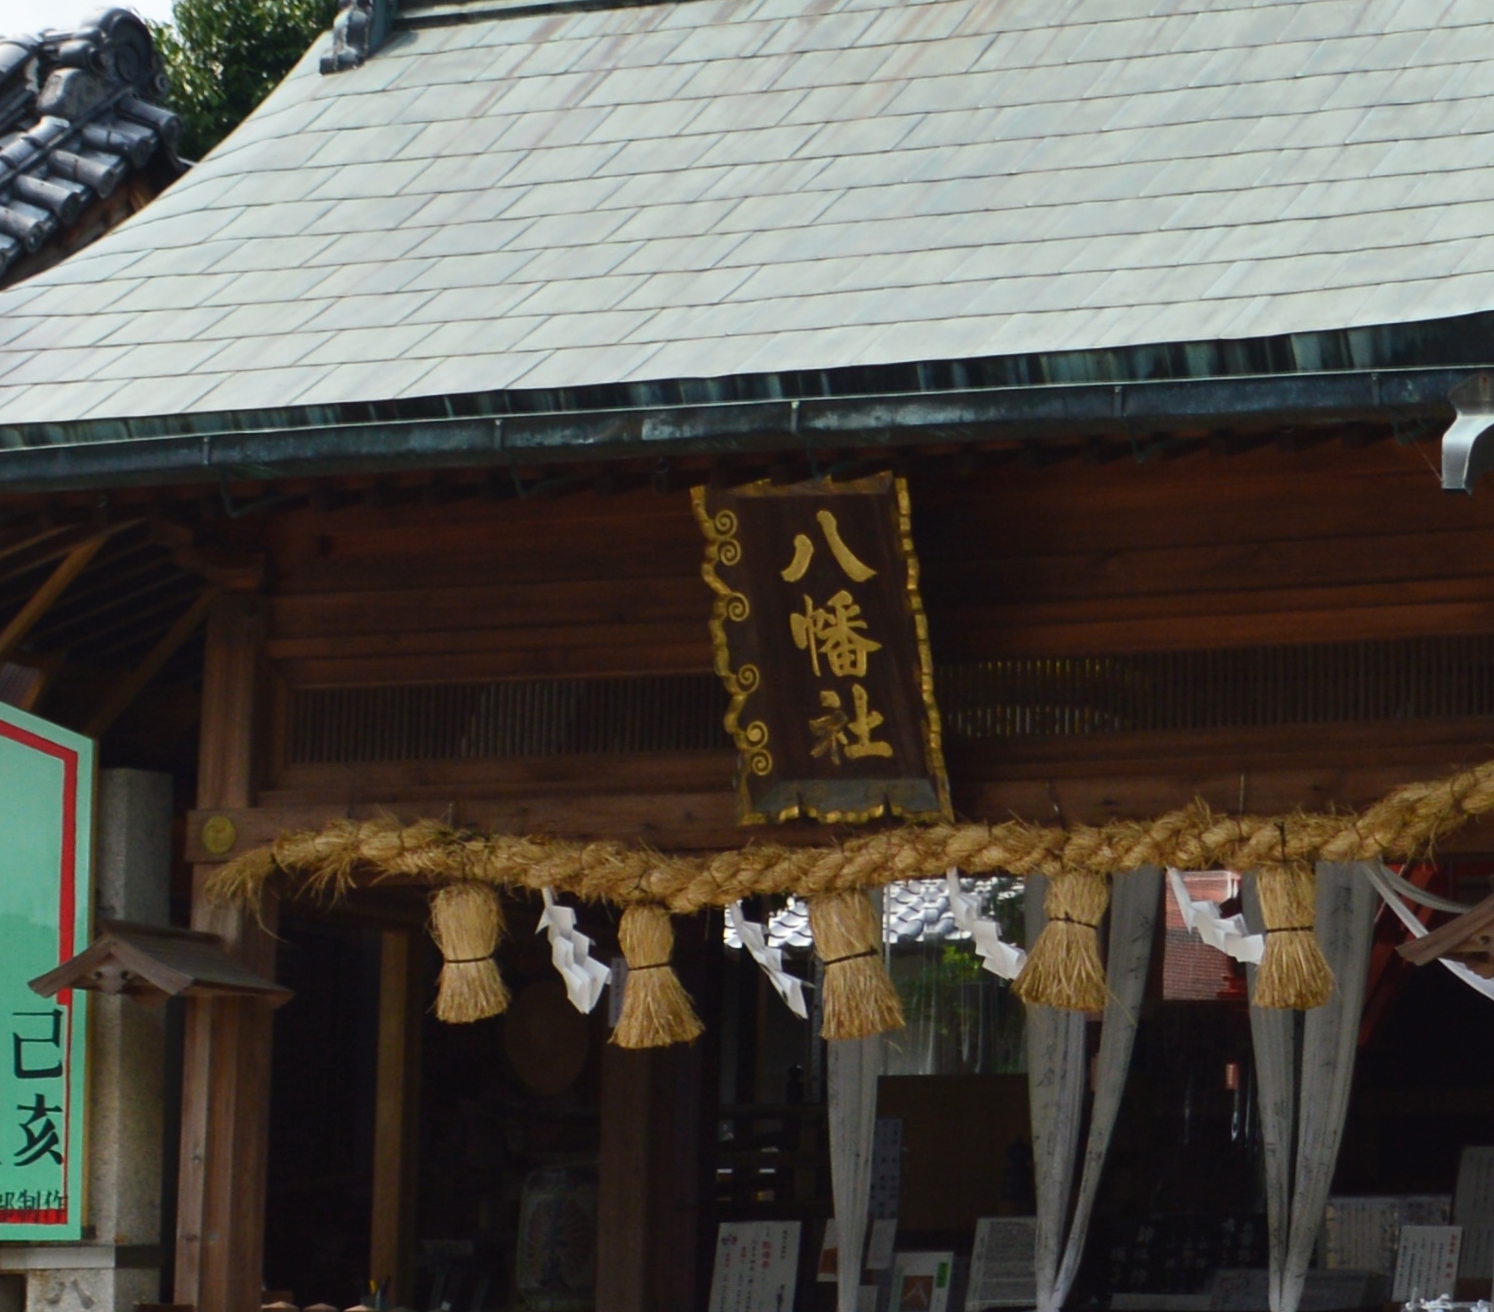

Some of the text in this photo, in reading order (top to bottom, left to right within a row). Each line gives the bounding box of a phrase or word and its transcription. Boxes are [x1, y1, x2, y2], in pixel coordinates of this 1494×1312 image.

[780, 510, 894, 765] 八幡社
[12, 1008, 64, 1167] 己亥
